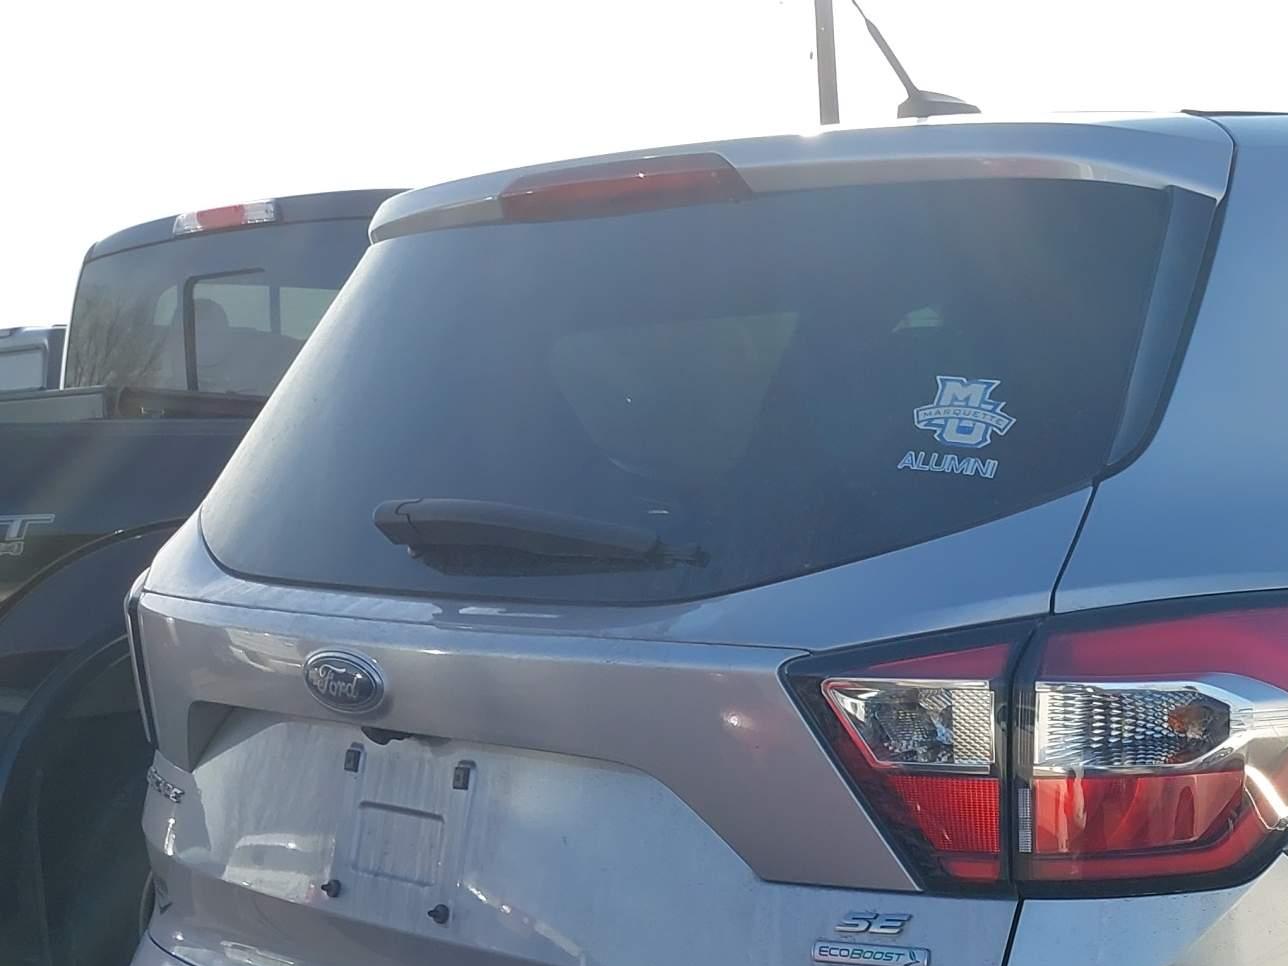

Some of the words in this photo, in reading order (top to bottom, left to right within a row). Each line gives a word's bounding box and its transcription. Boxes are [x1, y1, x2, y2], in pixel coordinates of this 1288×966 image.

[897, 451, 999, 479] ALUMNI
[317, 663, 363, 699] Ford
[834, 911, 913, 935] SE
[818, 945, 906, 962] ECOBOOST
